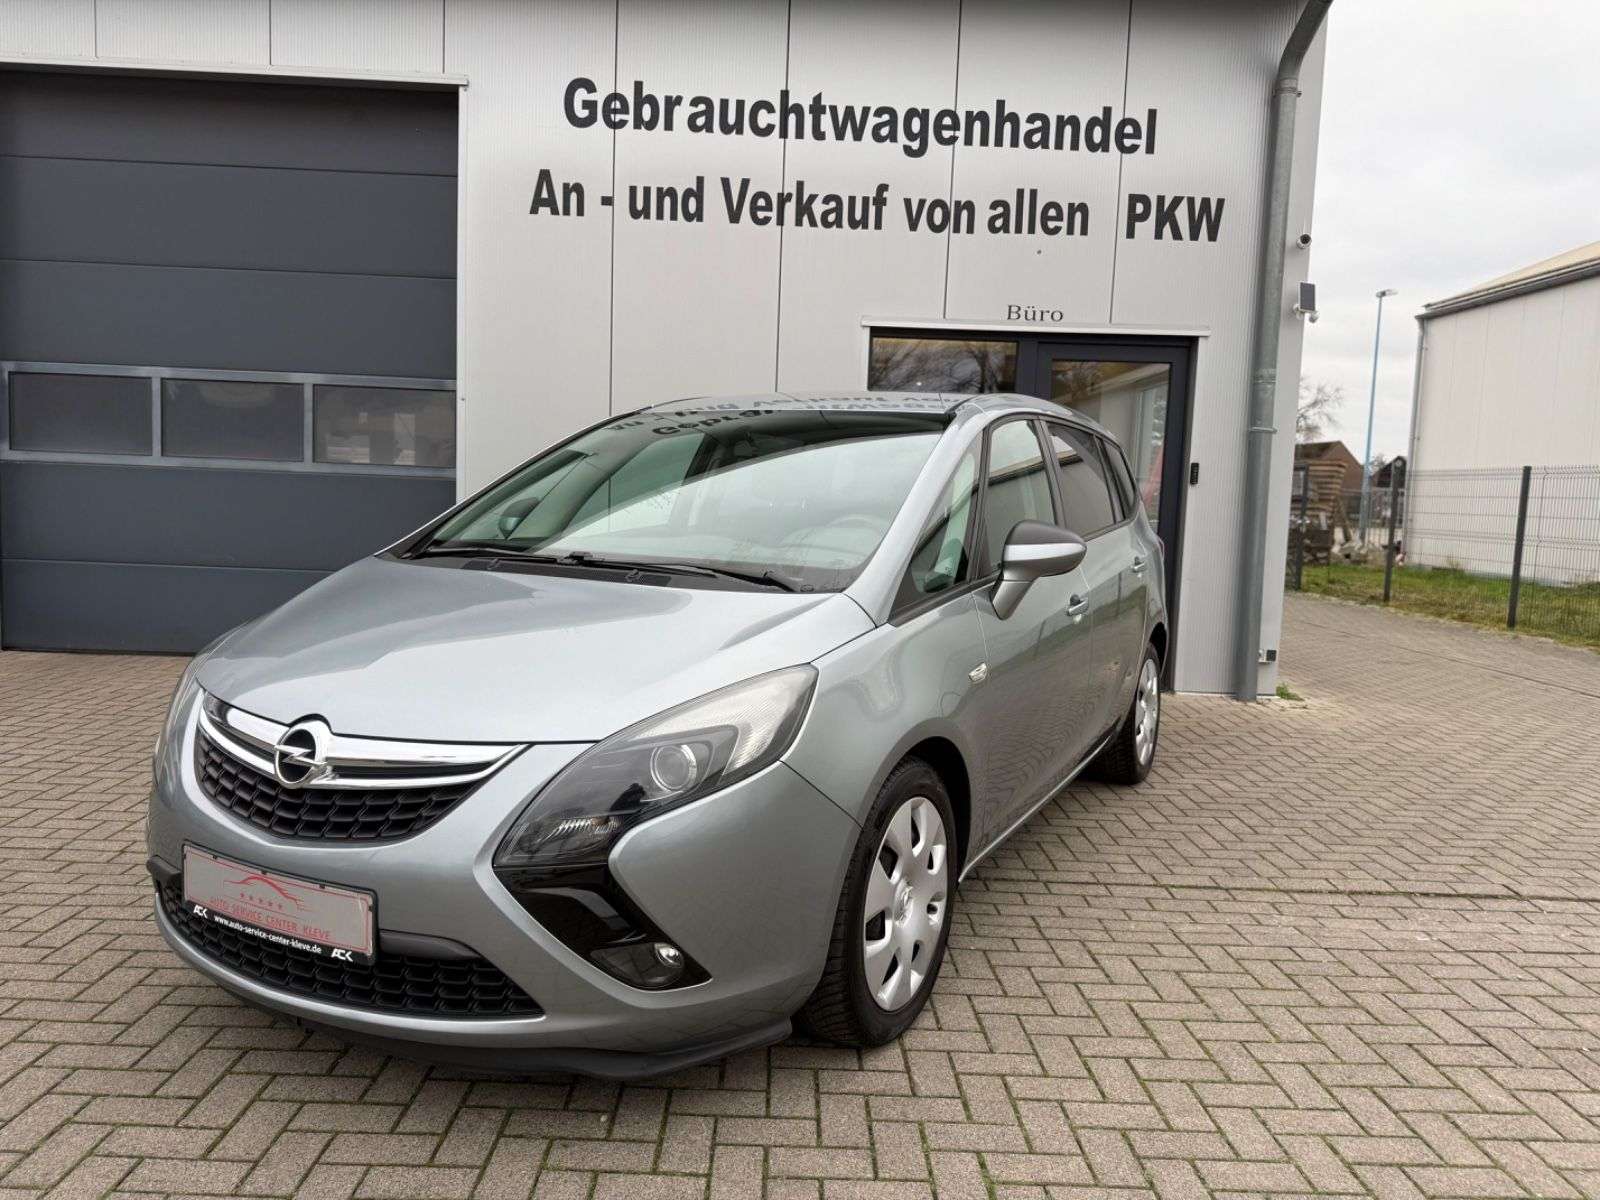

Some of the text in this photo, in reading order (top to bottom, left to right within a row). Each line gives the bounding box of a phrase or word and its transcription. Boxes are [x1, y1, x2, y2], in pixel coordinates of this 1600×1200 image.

[563, 77, 1157, 158] Gebrauchtwagenhandel
[529, 169, 585, 217] An
[628, 176, 705, 223] und
[720, 177, 889, 230] Verkauf
[903, 197, 976, 234] von
[987, 188, 1089, 236] allen
[1126, 193, 1225, 242] PKW
[1007, 304, 1064, 322] Büro
